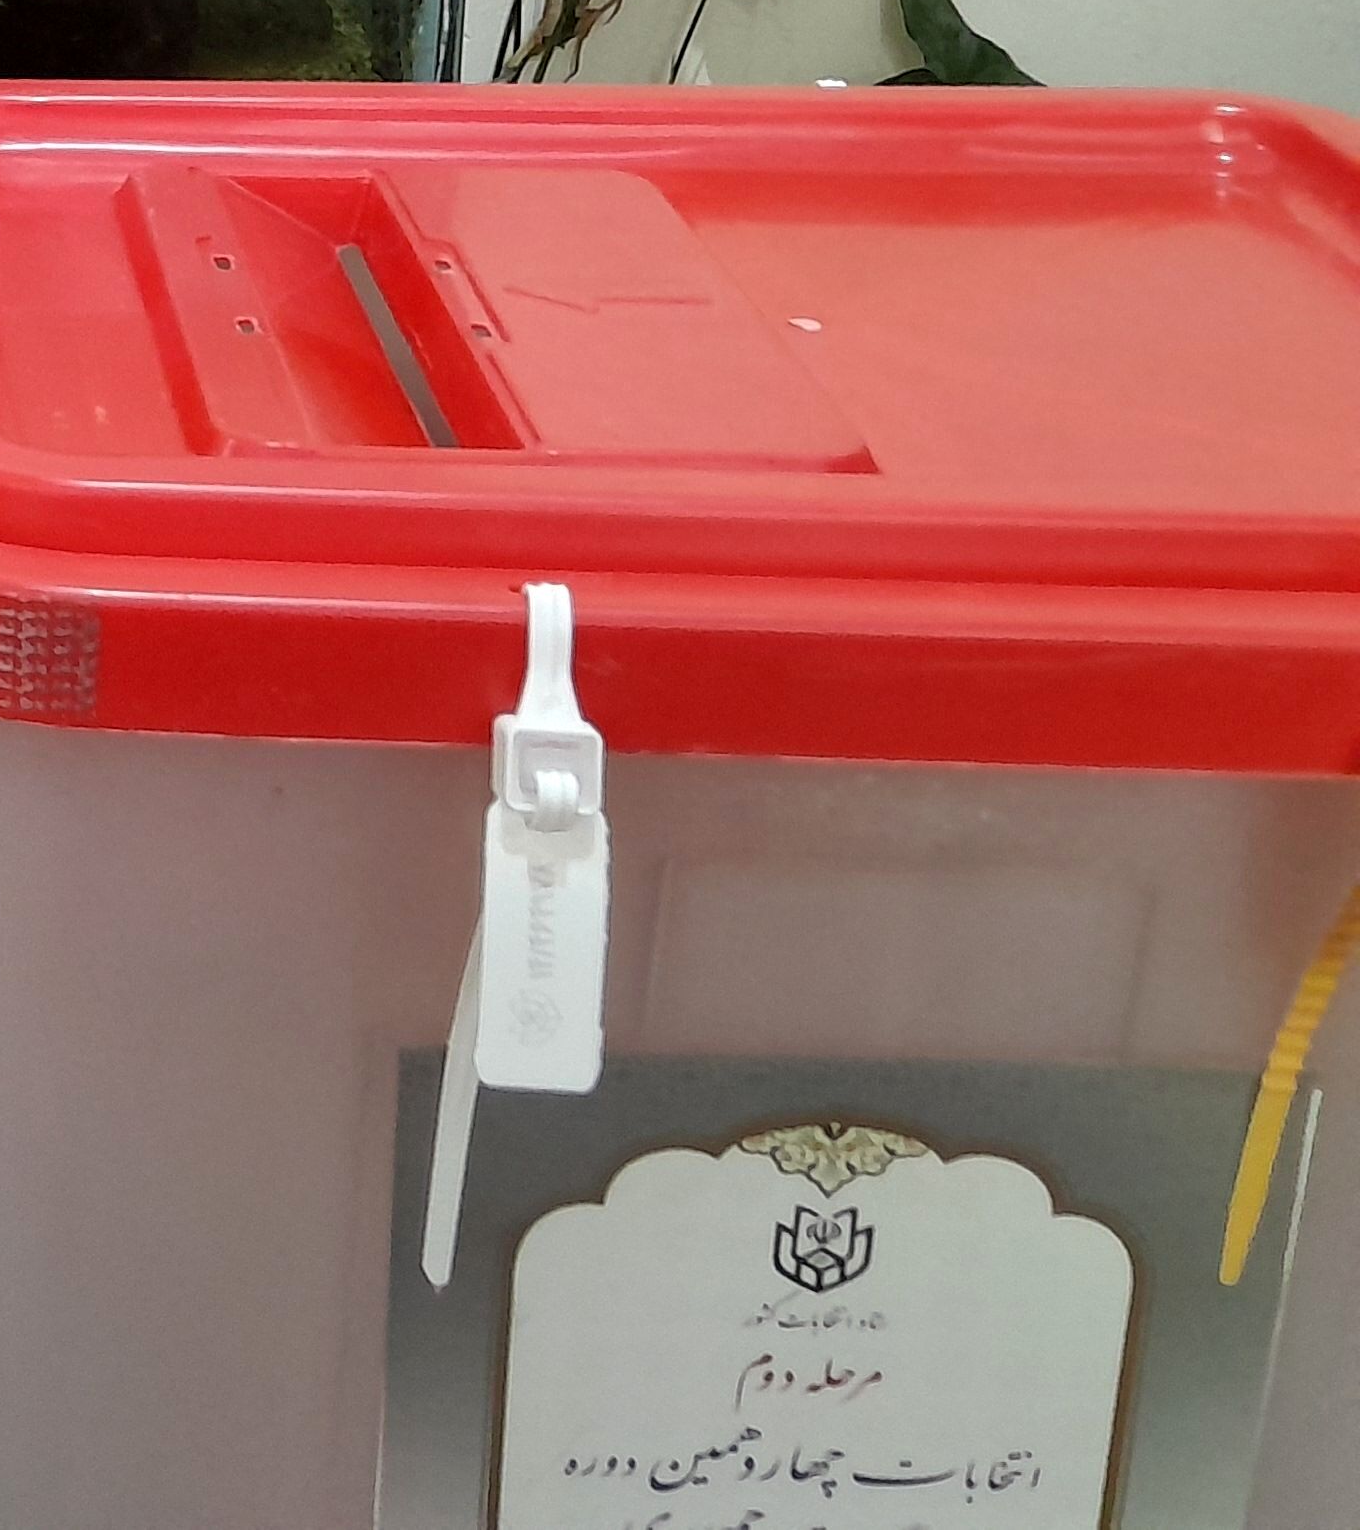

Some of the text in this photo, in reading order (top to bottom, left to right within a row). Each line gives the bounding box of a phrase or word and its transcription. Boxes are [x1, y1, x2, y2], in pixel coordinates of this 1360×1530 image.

[734, 1353, 883, 1413] مرحله دوم
[563, 1456, 638, 1478] دوره
[852, 1449, 1042, 1504] انتخابات
